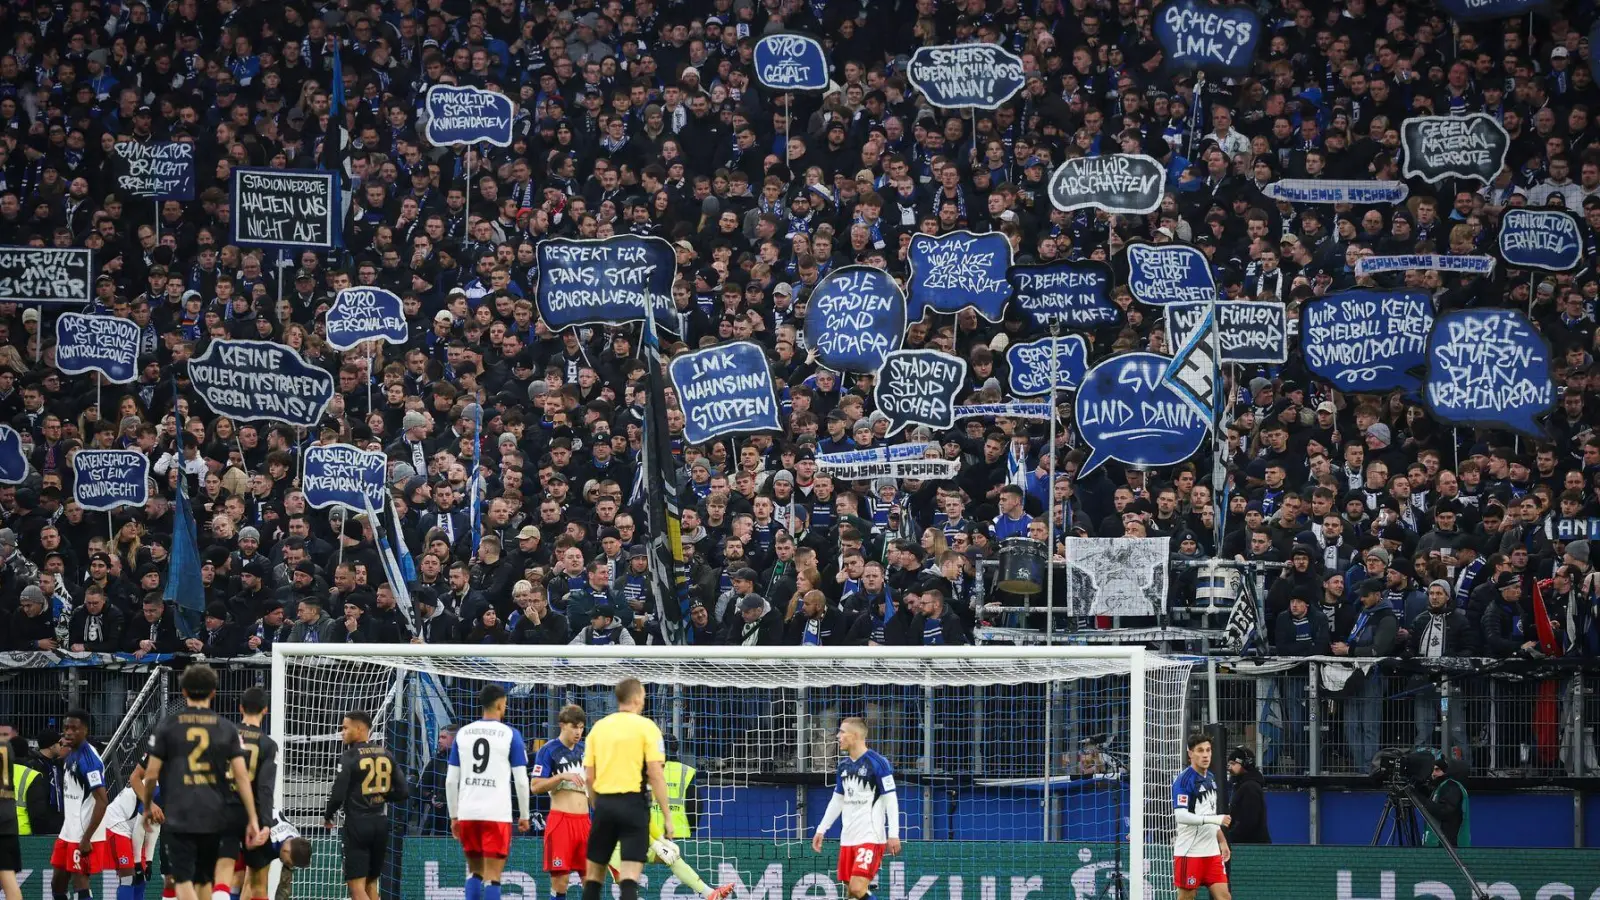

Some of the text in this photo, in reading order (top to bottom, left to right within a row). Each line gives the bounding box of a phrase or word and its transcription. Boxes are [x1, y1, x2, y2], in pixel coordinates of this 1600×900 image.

[1165, 6, 1252, 46] SCHEISS
[766, 37, 807, 57] PYRO
[930, 49, 996, 66] SCHEISS
[764, 65, 810, 83] GEWALT
[431, 92, 498, 110] FANKULTUR
[443, 104, 485, 116] STATT
[432, 116, 509, 131] KUNDENDATEN
[1419, 118, 1483, 137] GEGEN
[1421, 133, 1496, 153] MATERIAL
[127, 158, 188, 177] BRAUCHT
[1071, 157, 1131, 176] WILLKÜR
[1424, 150, 1492, 168] VERBOTE
[243, 173, 328, 196] STADIONVERBOTE
[1059, 174, 1158, 195] ABSCHAFFEN
[243, 192, 328, 217] HALTEN UNS
[248, 216, 321, 243] NICHT AUF
[1509, 213, 1574, 238] FANKULTUR
[939, 238, 978, 253] HAT
[1504, 230, 1577, 253] ERHALTEN
[545, 245, 648, 263] RESPEKT FÜR
[959, 252, 993, 266] NIE
[21, 266, 69, 281] MICH
[604, 264, 657, 285] STATT
[928, 264, 986, 279] ETWAS
[1141, 262, 1193, 279] STIRBT
[0, 278, 85, 298] SICHER
[833, 270, 876, 292] DIE
[1133, 281, 1212, 301] SICHERHEIT
[344, 291, 375, 307] PYRO
[817, 294, 893, 314] STADIEN
[1017, 293, 1096, 309] ZURÜCK IN
[337, 304, 385, 319] STATT
[1308, 301, 1338, 326] WIR
[1382, 294, 1425, 317] KEIN
[64, 318, 139, 340] DAS STADION
[328, 317, 404, 333] PERSONALIEN
[1309, 315, 1434, 345] SPIELBALL EURER
[74, 333, 137, 351] IST KEINE
[1307, 332, 1428, 367] SYMBOLPOLITI
[59, 345, 135, 365] KONTROLLZONE
[220, 346, 284, 369] KEINE
[890, 357, 956, 383] STADIEN
[1118, 362, 1167, 393] SV
[1450, 365, 1518, 389] PLAN
[191, 365, 329, 397] KOLLEKTIVSTRAFEN
[682, 371, 767, 401] WAHNSINN
[889, 376, 944, 397] SIND
[210, 387, 253, 411] GEGEN
[881, 394, 946, 420] SICHER
[690, 395, 770, 430] STOPPEN
[1082, 400, 1133, 427] UND
[76, 453, 141, 470] DATENSCHUTZ
[89, 467, 132, 480] IST EIN
[323, 463, 367, 482] STATT
[78, 481, 139, 500] GRUNDRECHT
[186, 727, 211, 772] 2
[472, 737, 491, 774] 9
[358, 756, 392, 795] 28
[72, 850, 81, 863] 6
[856, 847, 873, 865] 28
